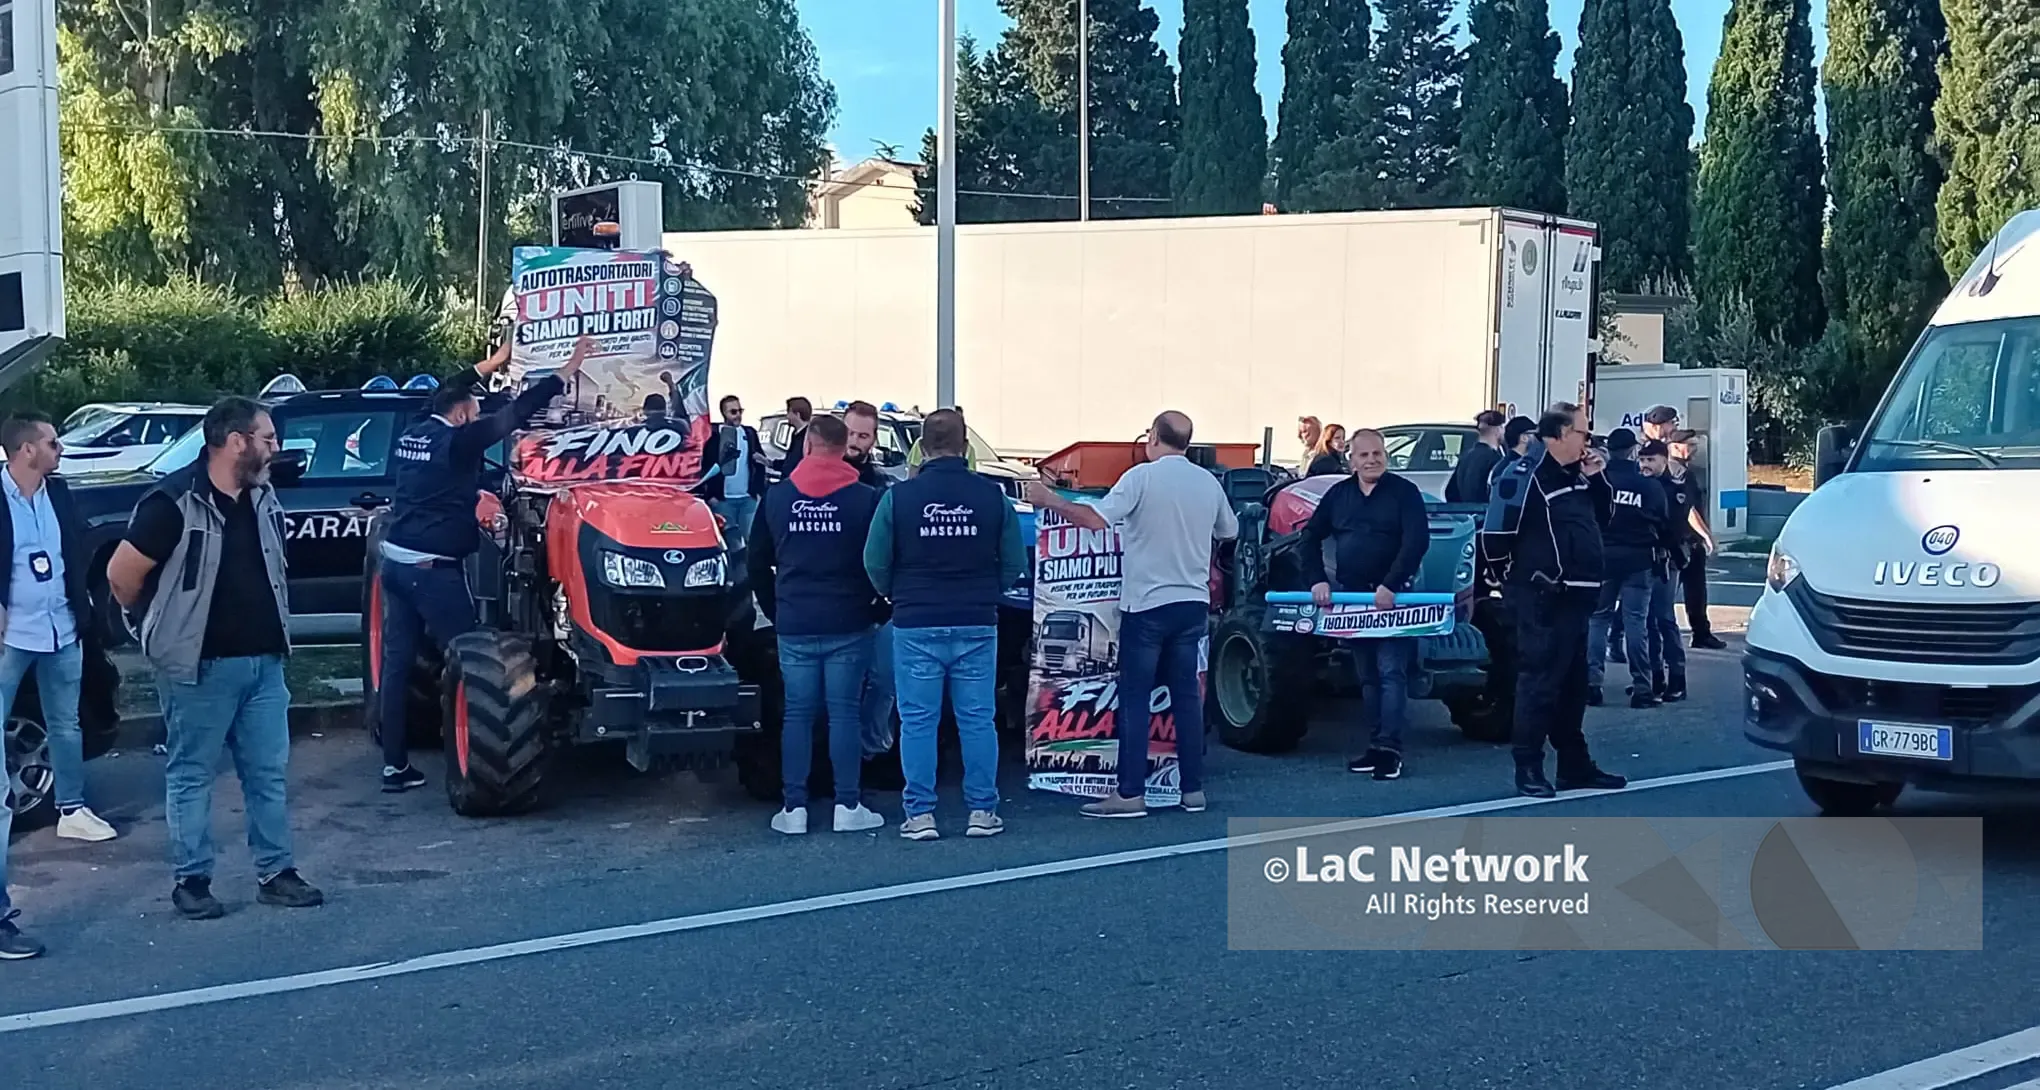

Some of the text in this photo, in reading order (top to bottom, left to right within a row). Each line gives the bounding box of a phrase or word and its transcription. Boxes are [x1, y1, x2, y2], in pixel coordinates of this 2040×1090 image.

[520, 261, 654, 293] AUTOTRASPORTATORI
[526, 280, 646, 321] UNITI
[521, 316, 579, 342] SIAMO
[583, 311, 610, 334] PIÙ
[613, 307, 657, 332] FORTI
[545, 428, 682, 463] FINO
[521, 453, 702, 481] ALLA FINE
[1613, 489, 1642, 508] IZIA
[788, 521, 842, 532] MASCARO
[919, 525, 978, 537] MASCARO
[1929, 530, 1953, 545] 040
[1043, 552, 1118, 581] SIAMO PIÙ
[1873, 560, 2001, 588] IVECO
[1323, 604, 1446, 630] AUTOTRASPORTATORI
[1032, 709, 1116, 741] ALLA
